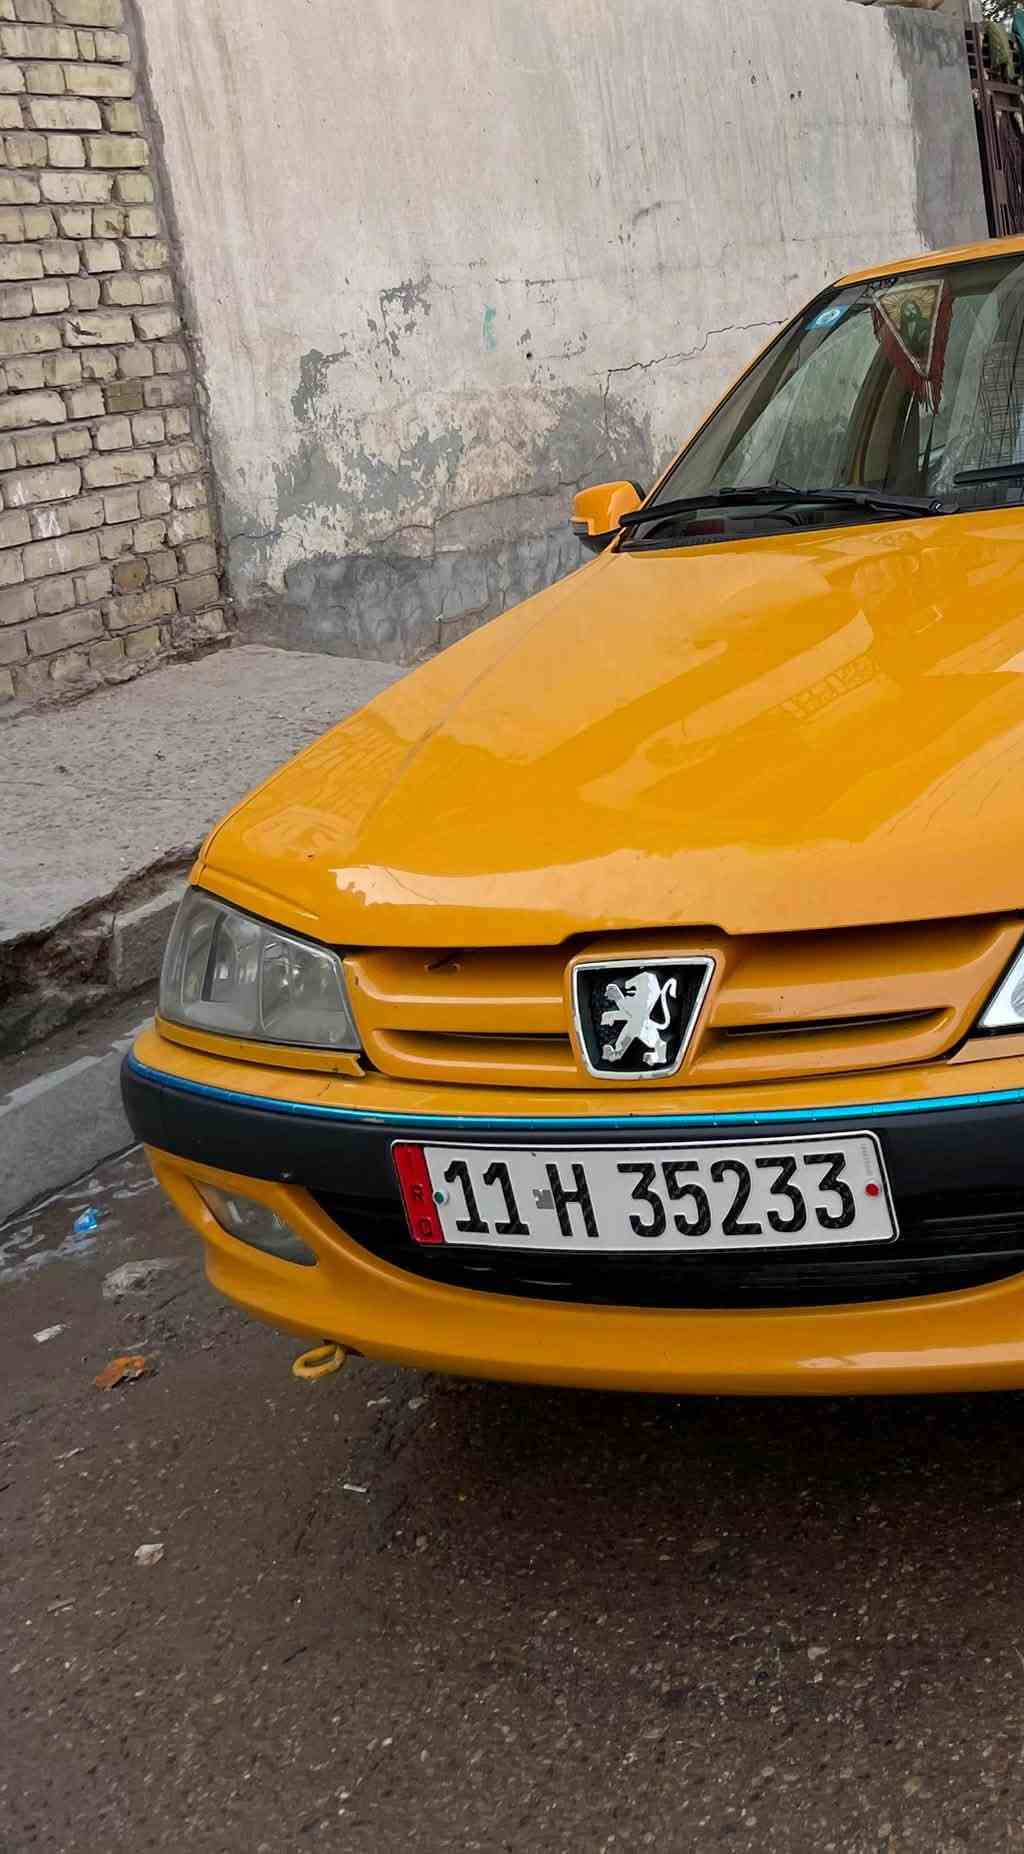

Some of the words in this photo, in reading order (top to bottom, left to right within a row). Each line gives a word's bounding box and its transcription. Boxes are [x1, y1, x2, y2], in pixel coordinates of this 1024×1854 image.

[443, 1160, 531, 1236] 11
[545, 1163, 600, 1238] H
[616, 1152, 856, 1238] 35233
